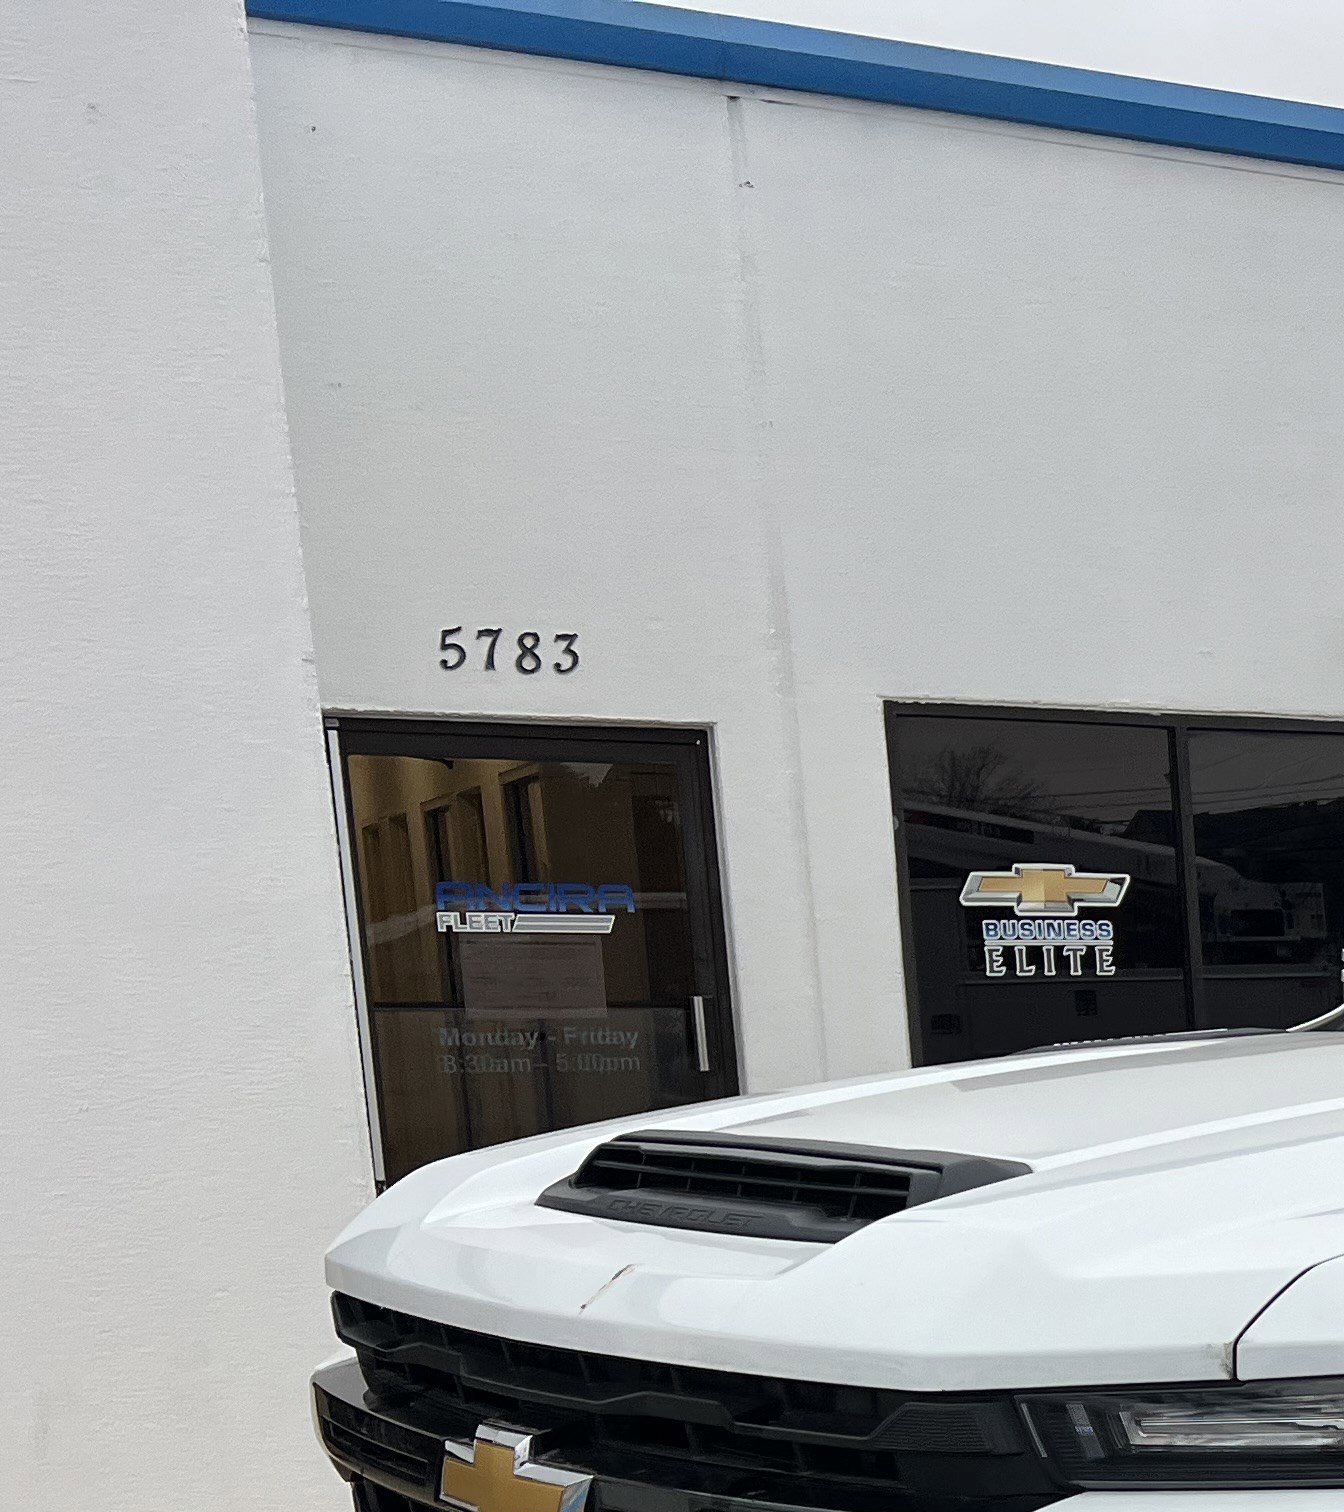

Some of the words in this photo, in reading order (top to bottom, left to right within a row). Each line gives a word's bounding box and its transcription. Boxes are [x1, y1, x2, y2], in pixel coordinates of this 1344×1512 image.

[439, 626, 580, 675] 5783
[435, 881, 636, 914] ANCIRA
[436, 911, 516, 933] FLEET
[982, 920, 1114, 940] BUSINESS
[984, 945, 1116, 977] ELITE
[438, 1026, 538, 1050] Monday
[563, 1026, 639, 1050] Friday
[607, 1198, 765, 1229] CHEVROLET
